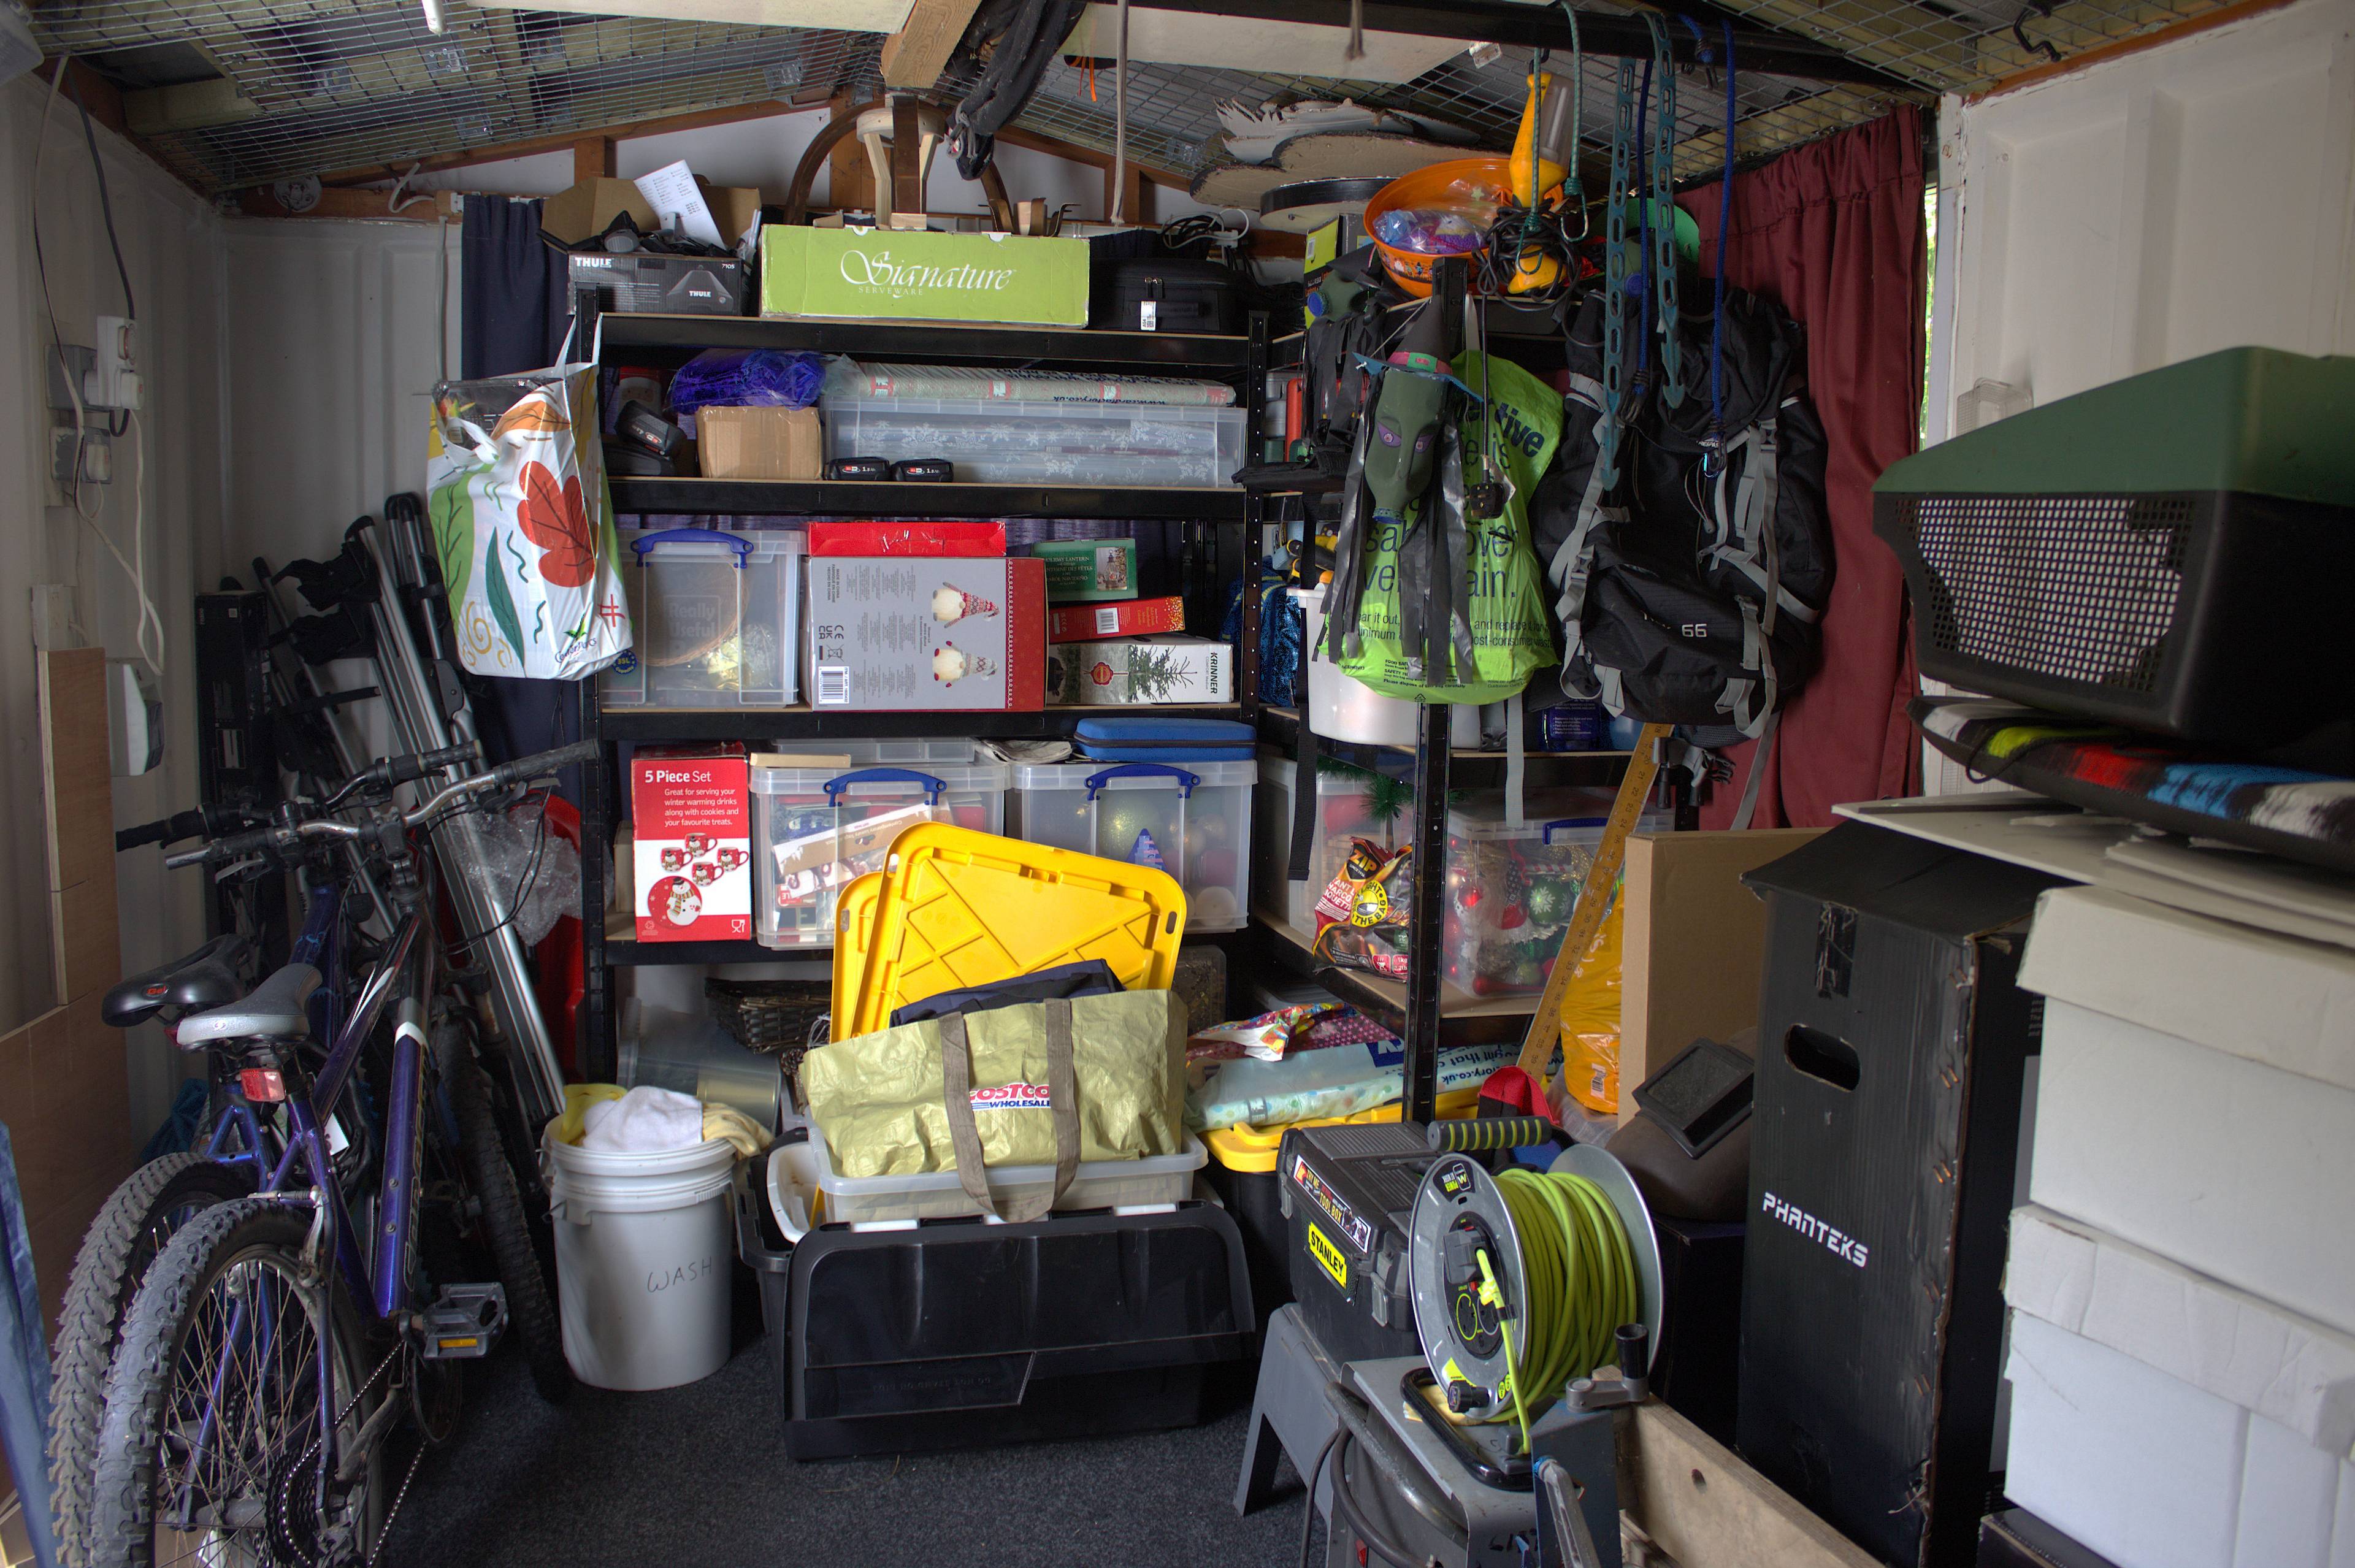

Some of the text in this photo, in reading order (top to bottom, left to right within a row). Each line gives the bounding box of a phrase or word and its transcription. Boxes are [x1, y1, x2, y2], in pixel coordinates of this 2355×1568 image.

[575, 258, 611, 268] THULE
[841, 250, 1016, 298] Signature
[859, 286, 923, 296] SERVEWARE
[669, 603, 715, 621] Really
[669, 622, 716, 637] Useful
[826, 625, 833, 638] UK
[1474, 619, 1492, 630] and
[1682, 623, 1707, 638] 66
[1472, 635, 1534, 646] ost-consumer
[645, 770, 711, 782] 5 Piece Set
[696, 788, 719, 797] serving
[1354, 849, 1377, 872] ZIP
[1313, 1177, 1320, 1189] ME
[1320, 1191, 1331, 1213] TOOL
[1331, 1205, 1342, 1225] BOX
[1763, 1191, 1868, 1268] PHANTEKS
[1311, 1231, 1343, 1277] STANLEY
[648, 1256, 711, 1293] WASH
